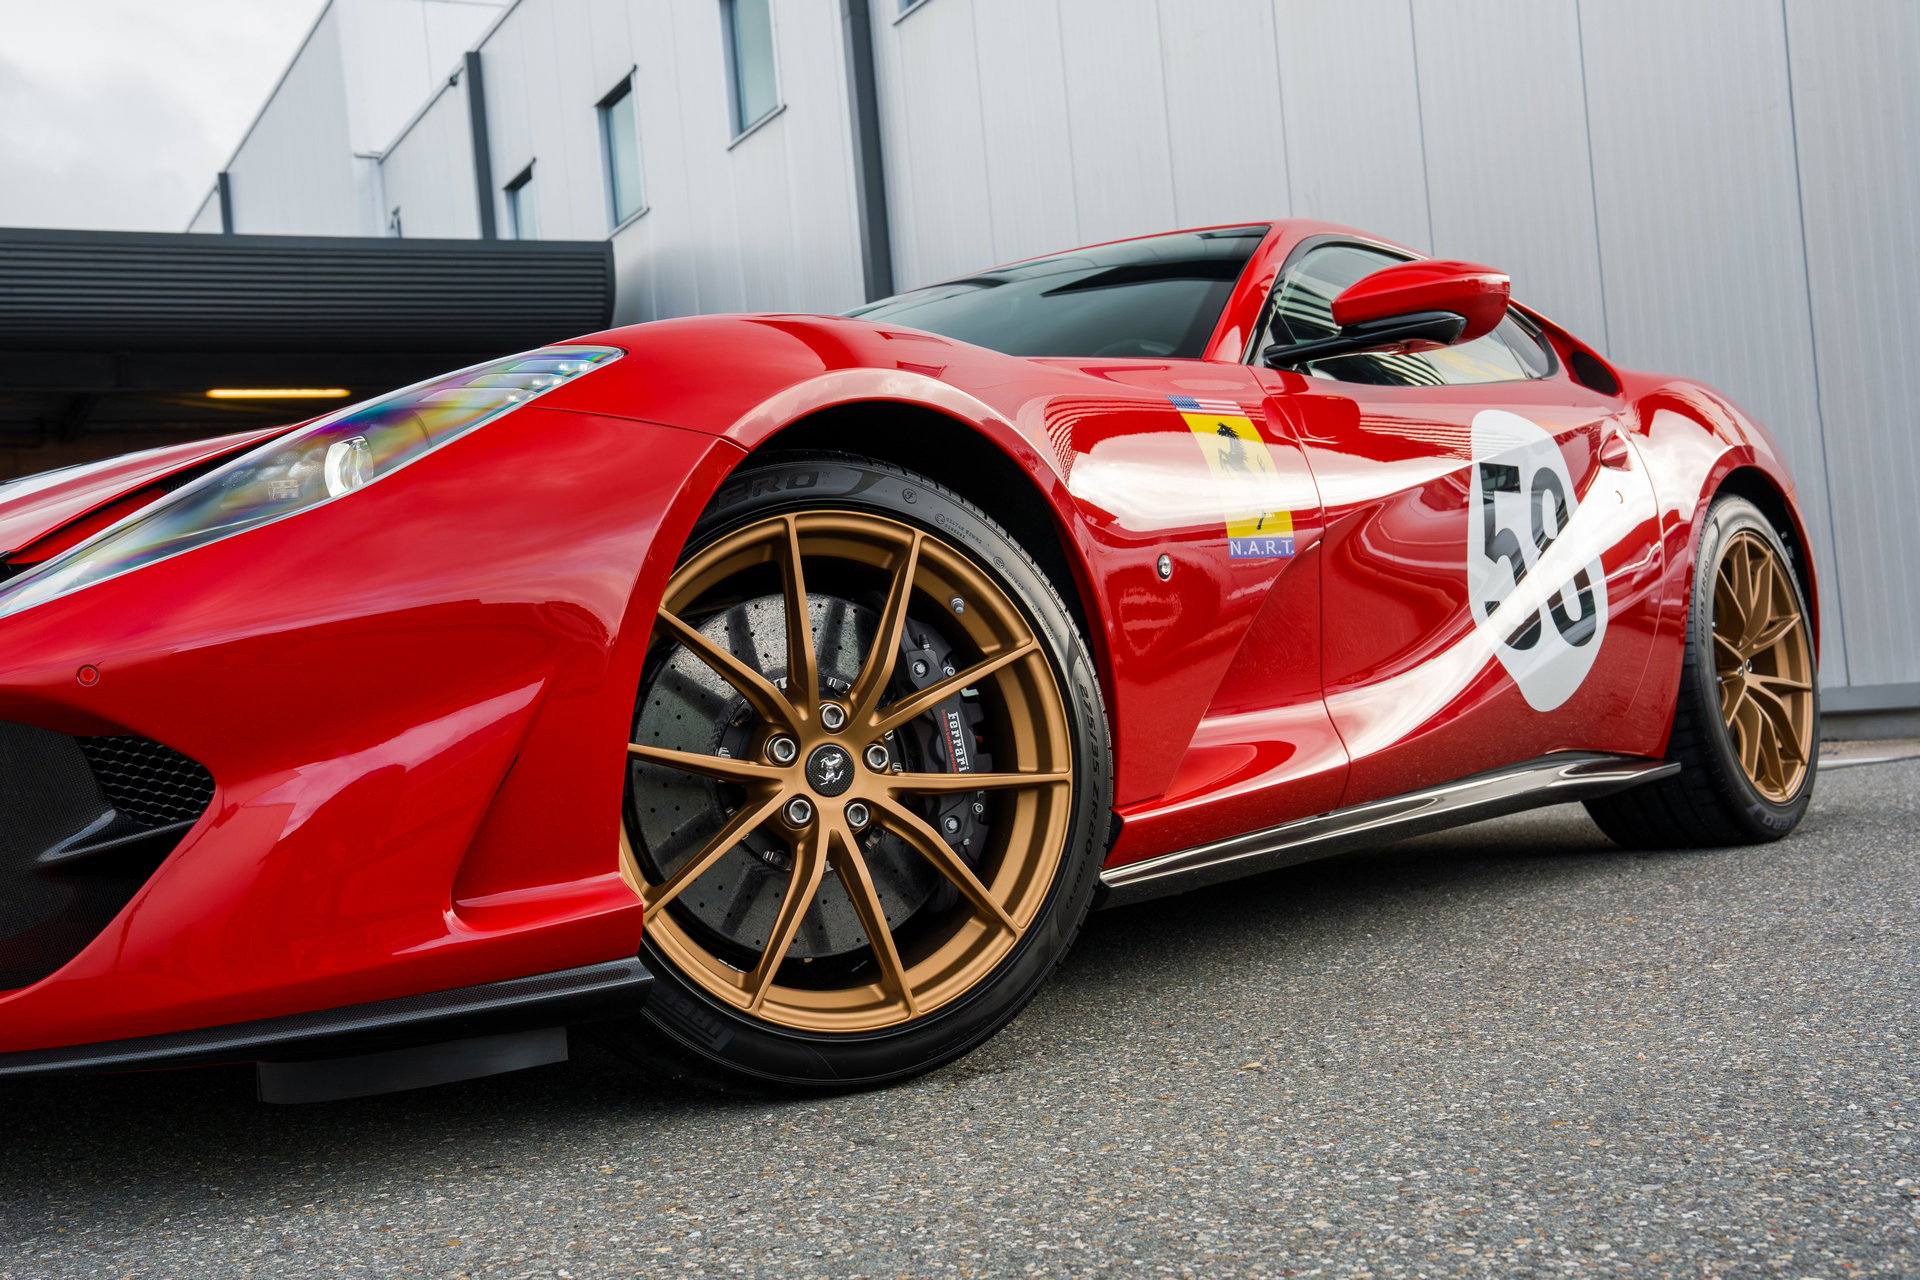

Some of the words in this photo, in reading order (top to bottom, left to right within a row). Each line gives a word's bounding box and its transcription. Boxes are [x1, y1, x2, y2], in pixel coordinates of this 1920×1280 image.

[705, 471, 819, 512] ERO
[1229, 539, 1295, 556] N.A.R.T.
[1479, 462, 1597, 650] 58
[947, 711, 970, 772] Ferrari
[1079, 683, 1100, 776] 275/35
[1085, 780, 1100, 855] ZR20
[651, 980, 735, 1052] PIREL
